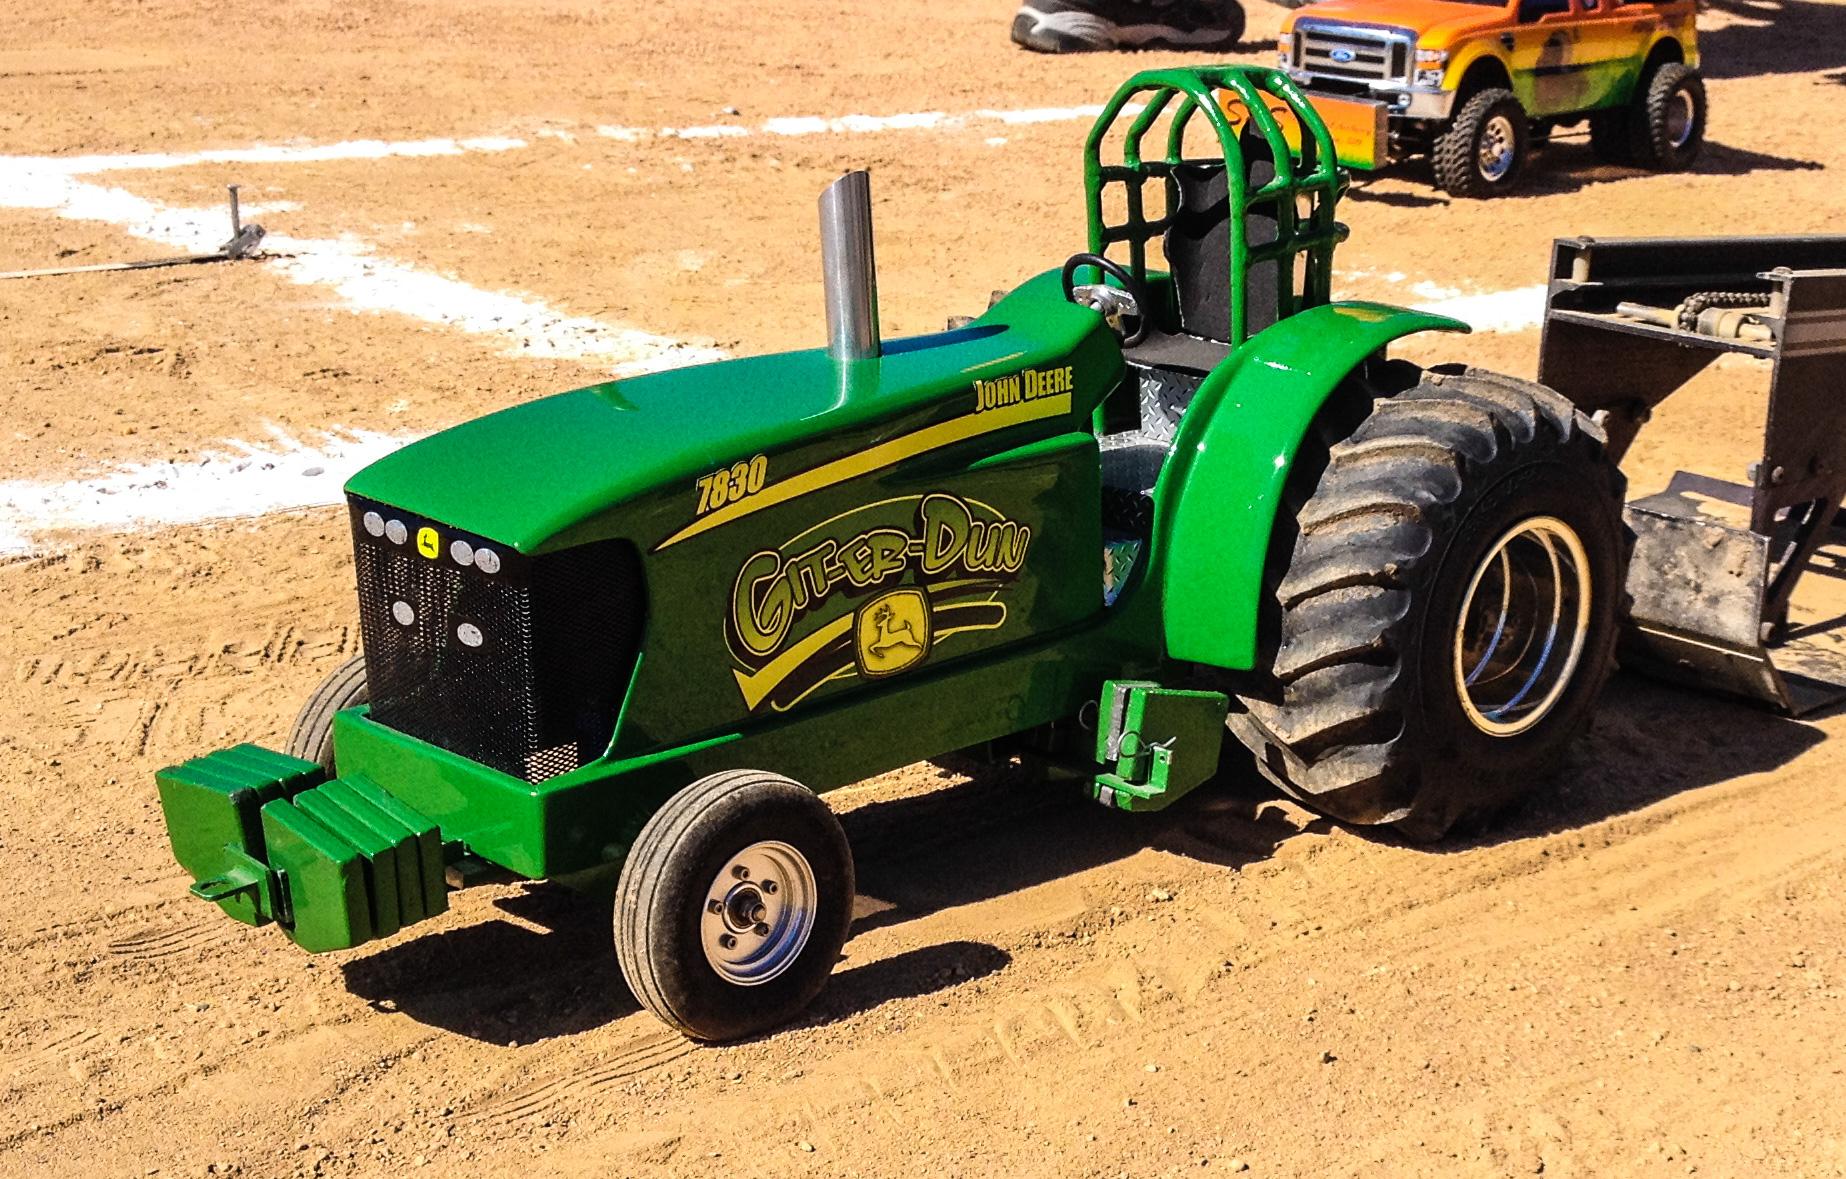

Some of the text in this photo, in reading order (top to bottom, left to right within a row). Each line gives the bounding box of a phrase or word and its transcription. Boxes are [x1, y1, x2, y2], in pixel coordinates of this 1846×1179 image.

[974, 366, 1073, 412] JOHN DEERE
[696, 453, 768, 516] 7830
